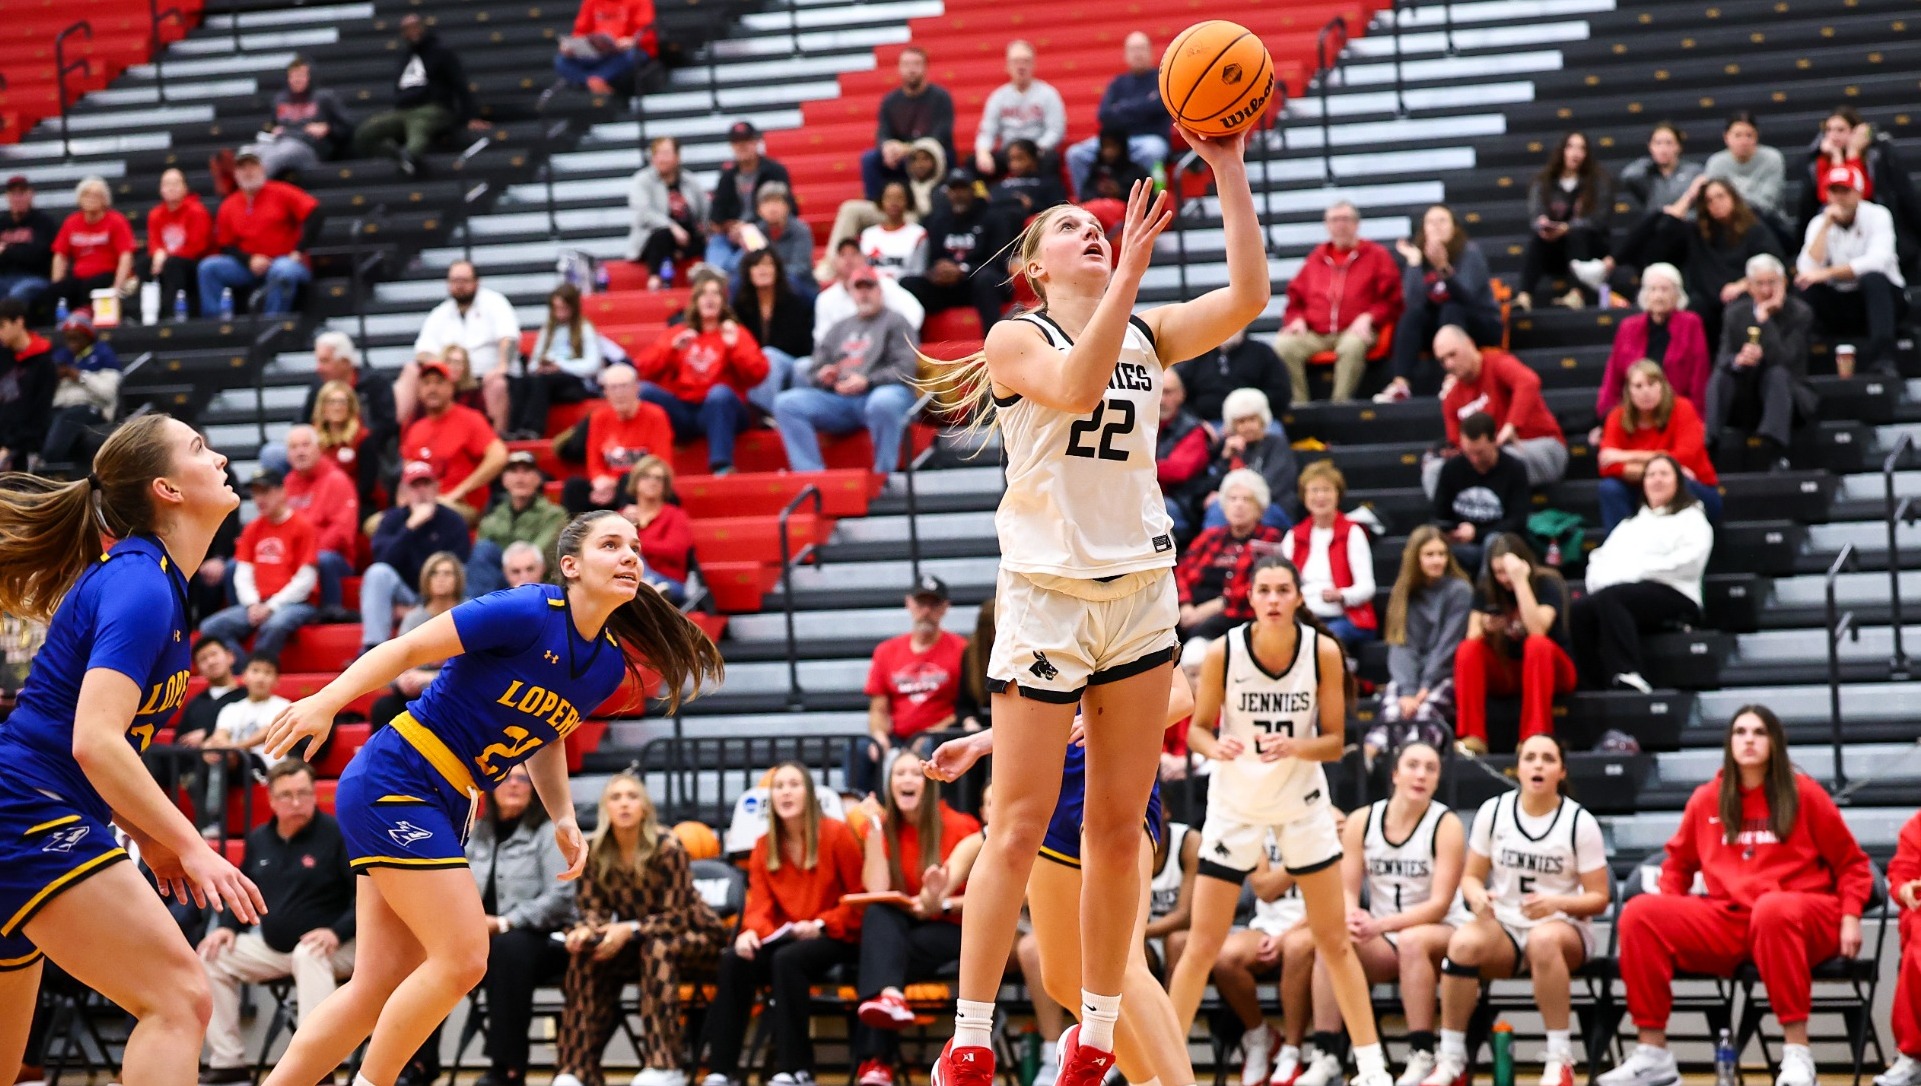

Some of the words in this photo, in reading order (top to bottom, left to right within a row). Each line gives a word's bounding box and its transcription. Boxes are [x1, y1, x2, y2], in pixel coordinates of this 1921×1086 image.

[1220, 72, 1274, 128] Wilson
[1065, 399, 1135, 461] 22
[1238, 692, 1310, 712] JENNIES
[1499, 849, 1563, 874] JENNIES
[1394, 884, 1402, 913] 1
